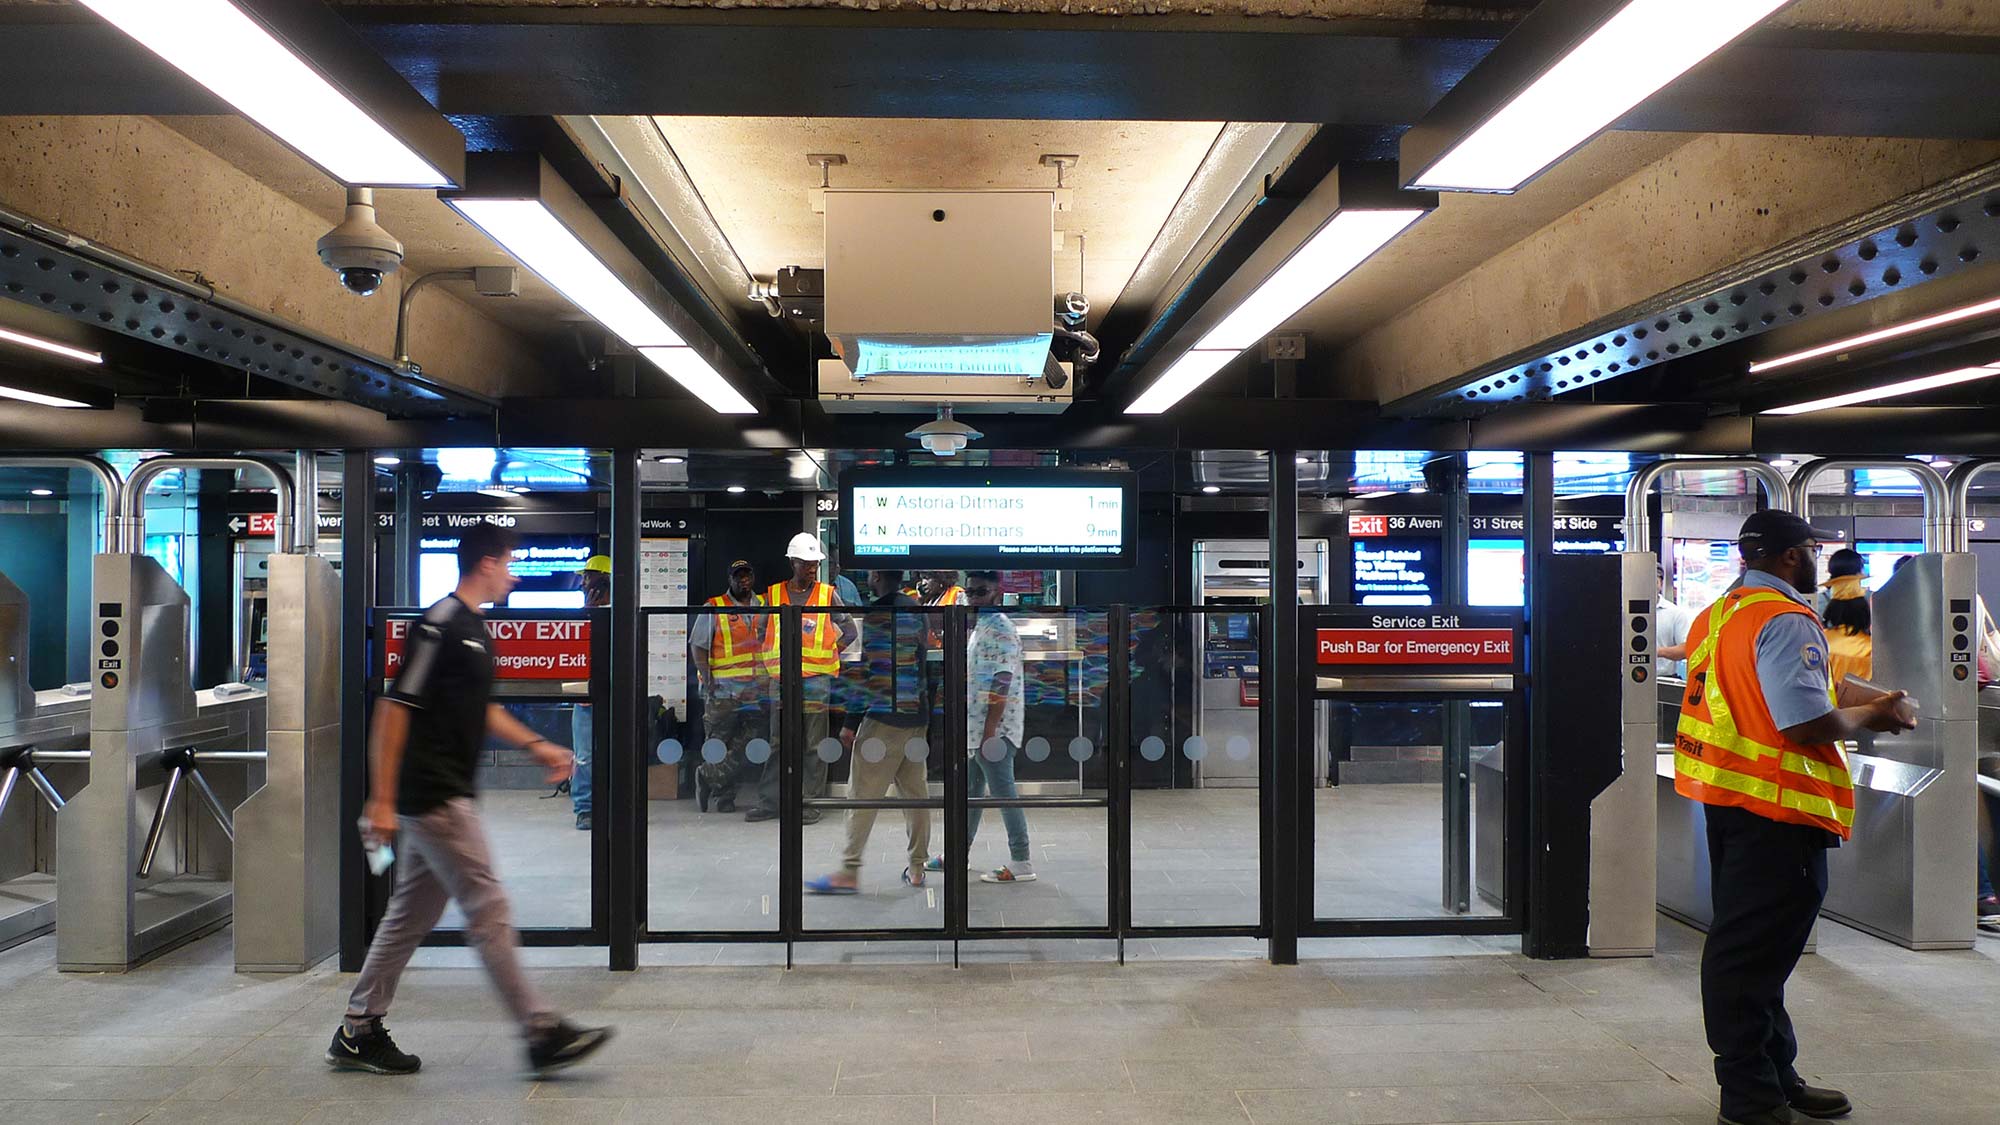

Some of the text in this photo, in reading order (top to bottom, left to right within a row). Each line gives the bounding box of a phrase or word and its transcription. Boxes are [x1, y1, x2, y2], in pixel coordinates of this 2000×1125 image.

[817, 499, 833, 511] 36
[876, 497, 888, 507] W
[1088, 495, 1094, 509] 1
[1098, 501, 1118, 509] min
[379, 514, 394, 527] 31
[650, 520, 672, 528] Work
[1349, 517, 1383, 533] Exit
[1389, 517, 1406, 529] 36
[1473, 518, 1487, 529] 31
[1568, 517, 1598, 529] Side
[859, 523, 868, 537] 4
[878, 525, 887, 535] N
[1086, 523, 1096, 537] 9
[1097, 529, 1118, 537] min
[1081, 546, 1108, 554] platform
[1372, 615, 1460, 628] Service Exit
[536, 622, 585, 640] EXIT
[1320, 640, 1510, 656] Push Bar for Emergency Exit
[559, 653, 587, 667] Exit
[1631, 655, 1646, 663] Exit
[1953, 653, 1967, 661] Exit
[103, 660, 118, 669] Exit
